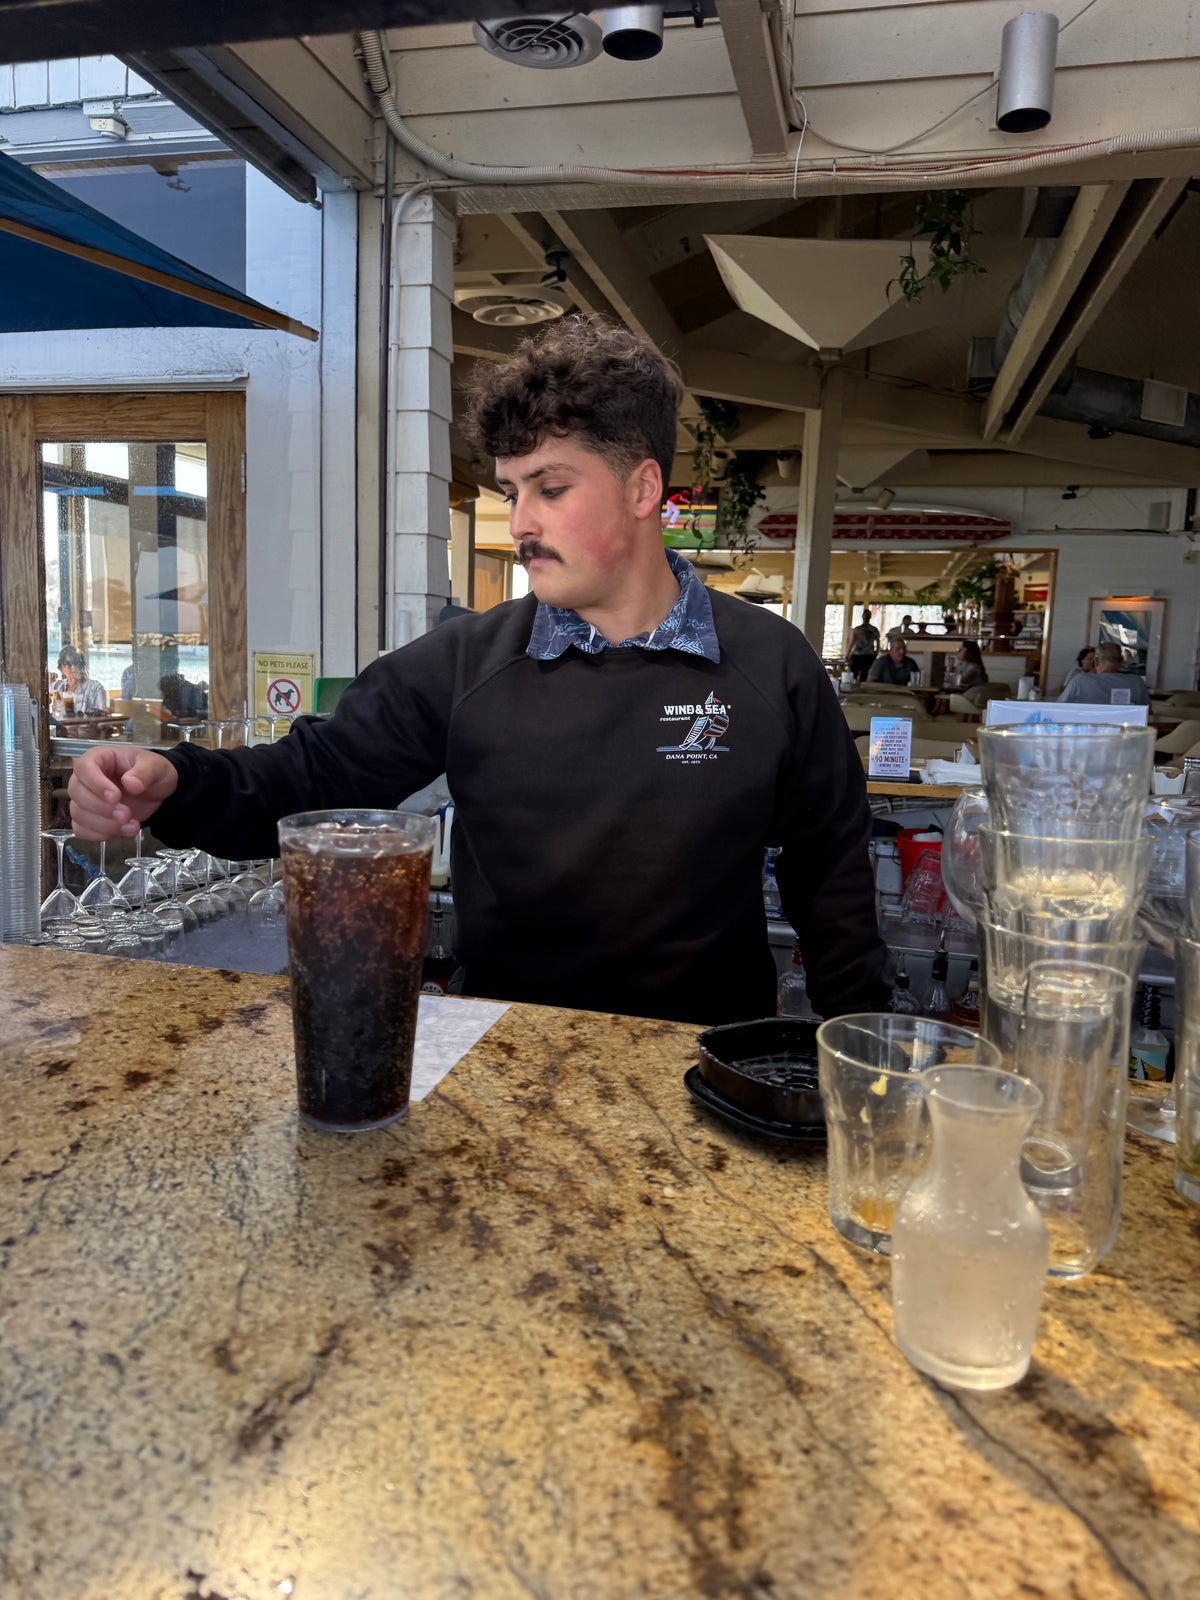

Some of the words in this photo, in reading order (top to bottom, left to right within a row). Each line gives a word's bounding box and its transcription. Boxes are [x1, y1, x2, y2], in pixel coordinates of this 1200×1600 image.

[269, 660, 285, 668] PETS
[286, 661, 308, 669] PLEASE
[664, 705, 694, 715] WIND
[884, 755, 904, 763] MINUTE
